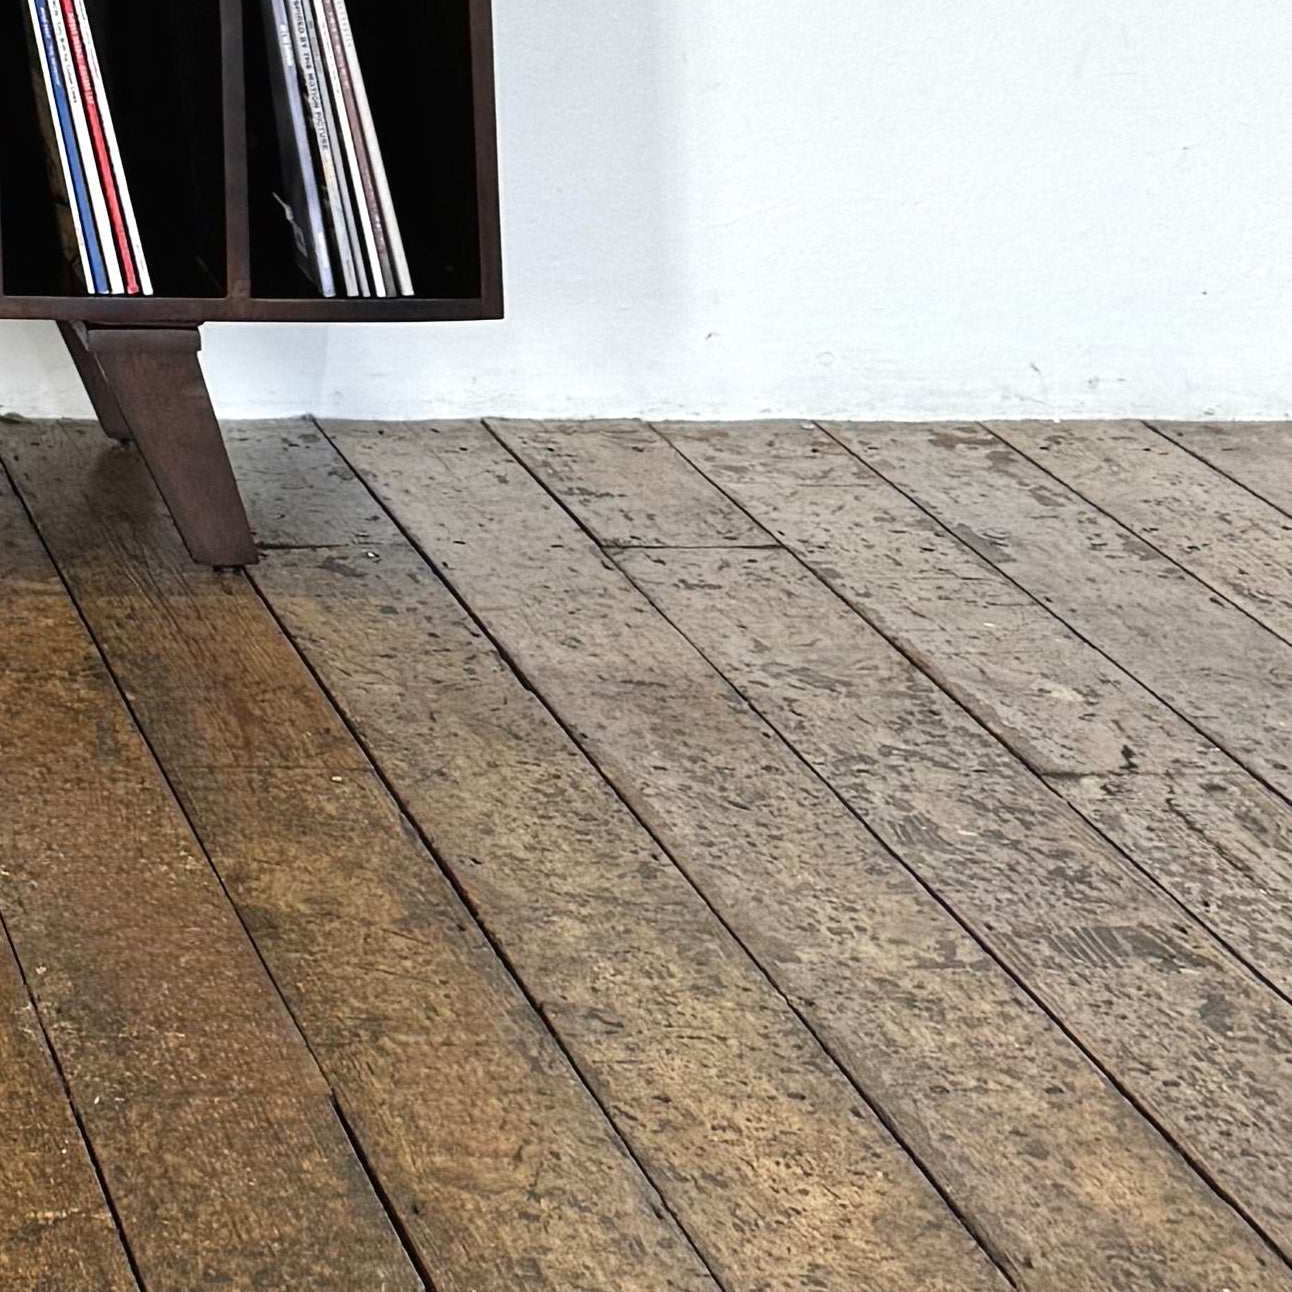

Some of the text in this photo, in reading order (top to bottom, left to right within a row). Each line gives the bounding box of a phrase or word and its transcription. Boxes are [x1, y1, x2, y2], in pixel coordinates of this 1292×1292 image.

[300, 35, 307, 48] BY
[303, 52, 311, 69] THE
[307, 73, 319, 108] MOTION
[315, 111, 328, 148] PICTURE
